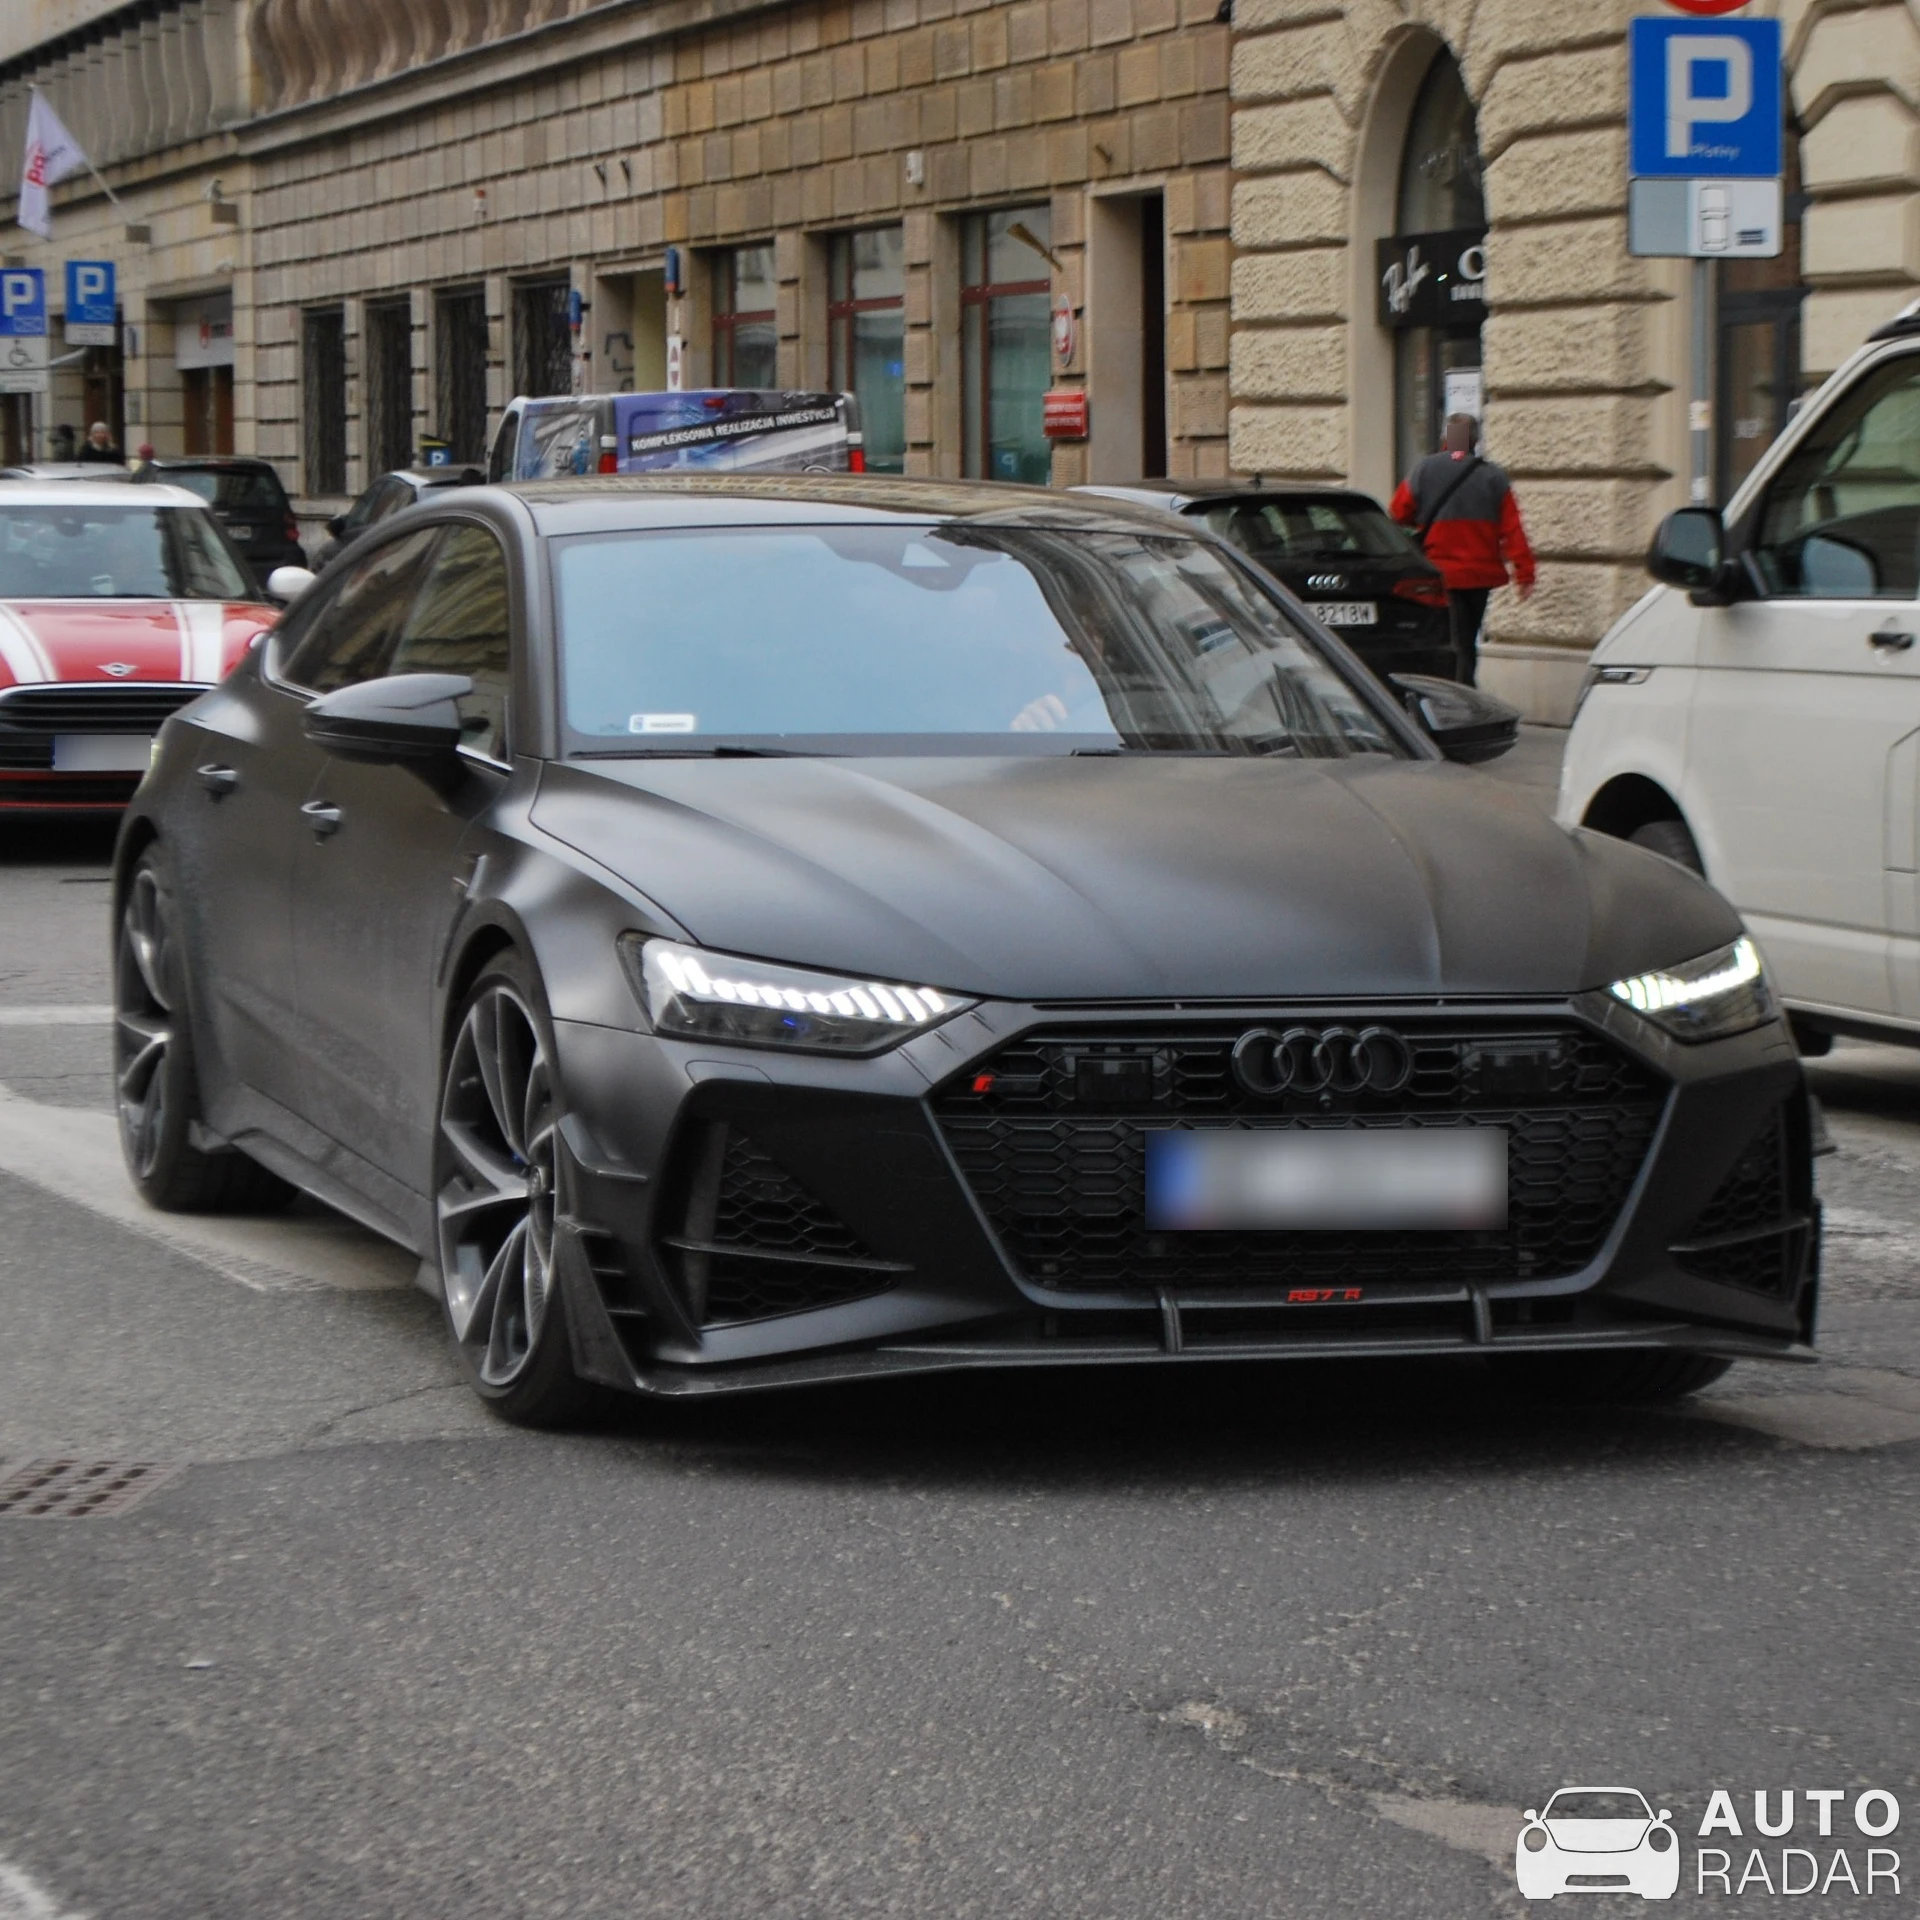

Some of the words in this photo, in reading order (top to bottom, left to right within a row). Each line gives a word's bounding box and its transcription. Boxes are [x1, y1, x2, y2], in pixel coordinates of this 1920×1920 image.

[1665, 34, 1752, 158] P
[2, 274, 35, 317] P
[75, 267, 105, 305] P
[632, 426, 714, 451] KOMPLEKSOWA
[715, 415, 775, 437] REALIZACJA
[776, 406, 836, 427] INWESTYCJI
